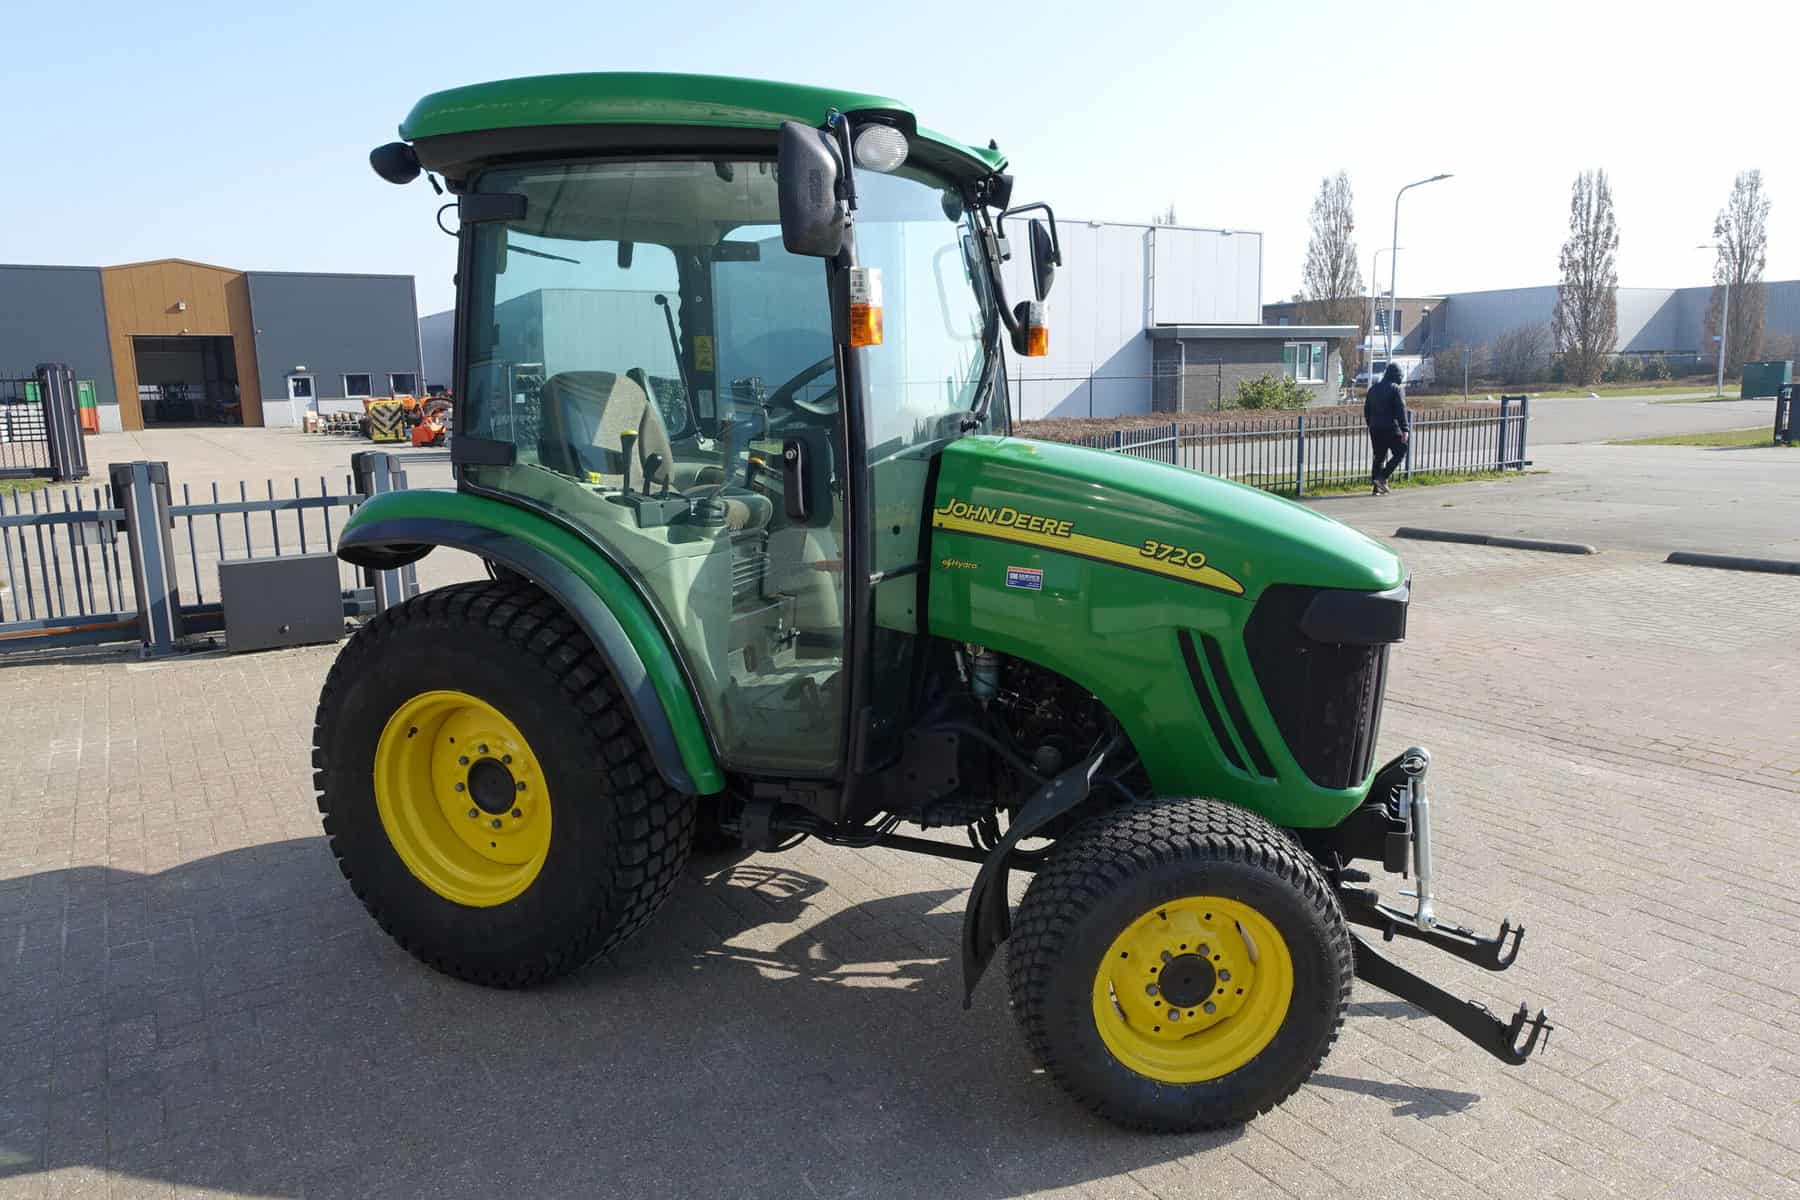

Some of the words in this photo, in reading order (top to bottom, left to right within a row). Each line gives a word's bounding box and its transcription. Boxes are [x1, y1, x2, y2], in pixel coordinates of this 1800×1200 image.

[937, 497, 997, 524] JOHN
[996, 507, 1074, 538] DEERE
[1140, 539, 1207, 568] 3720
